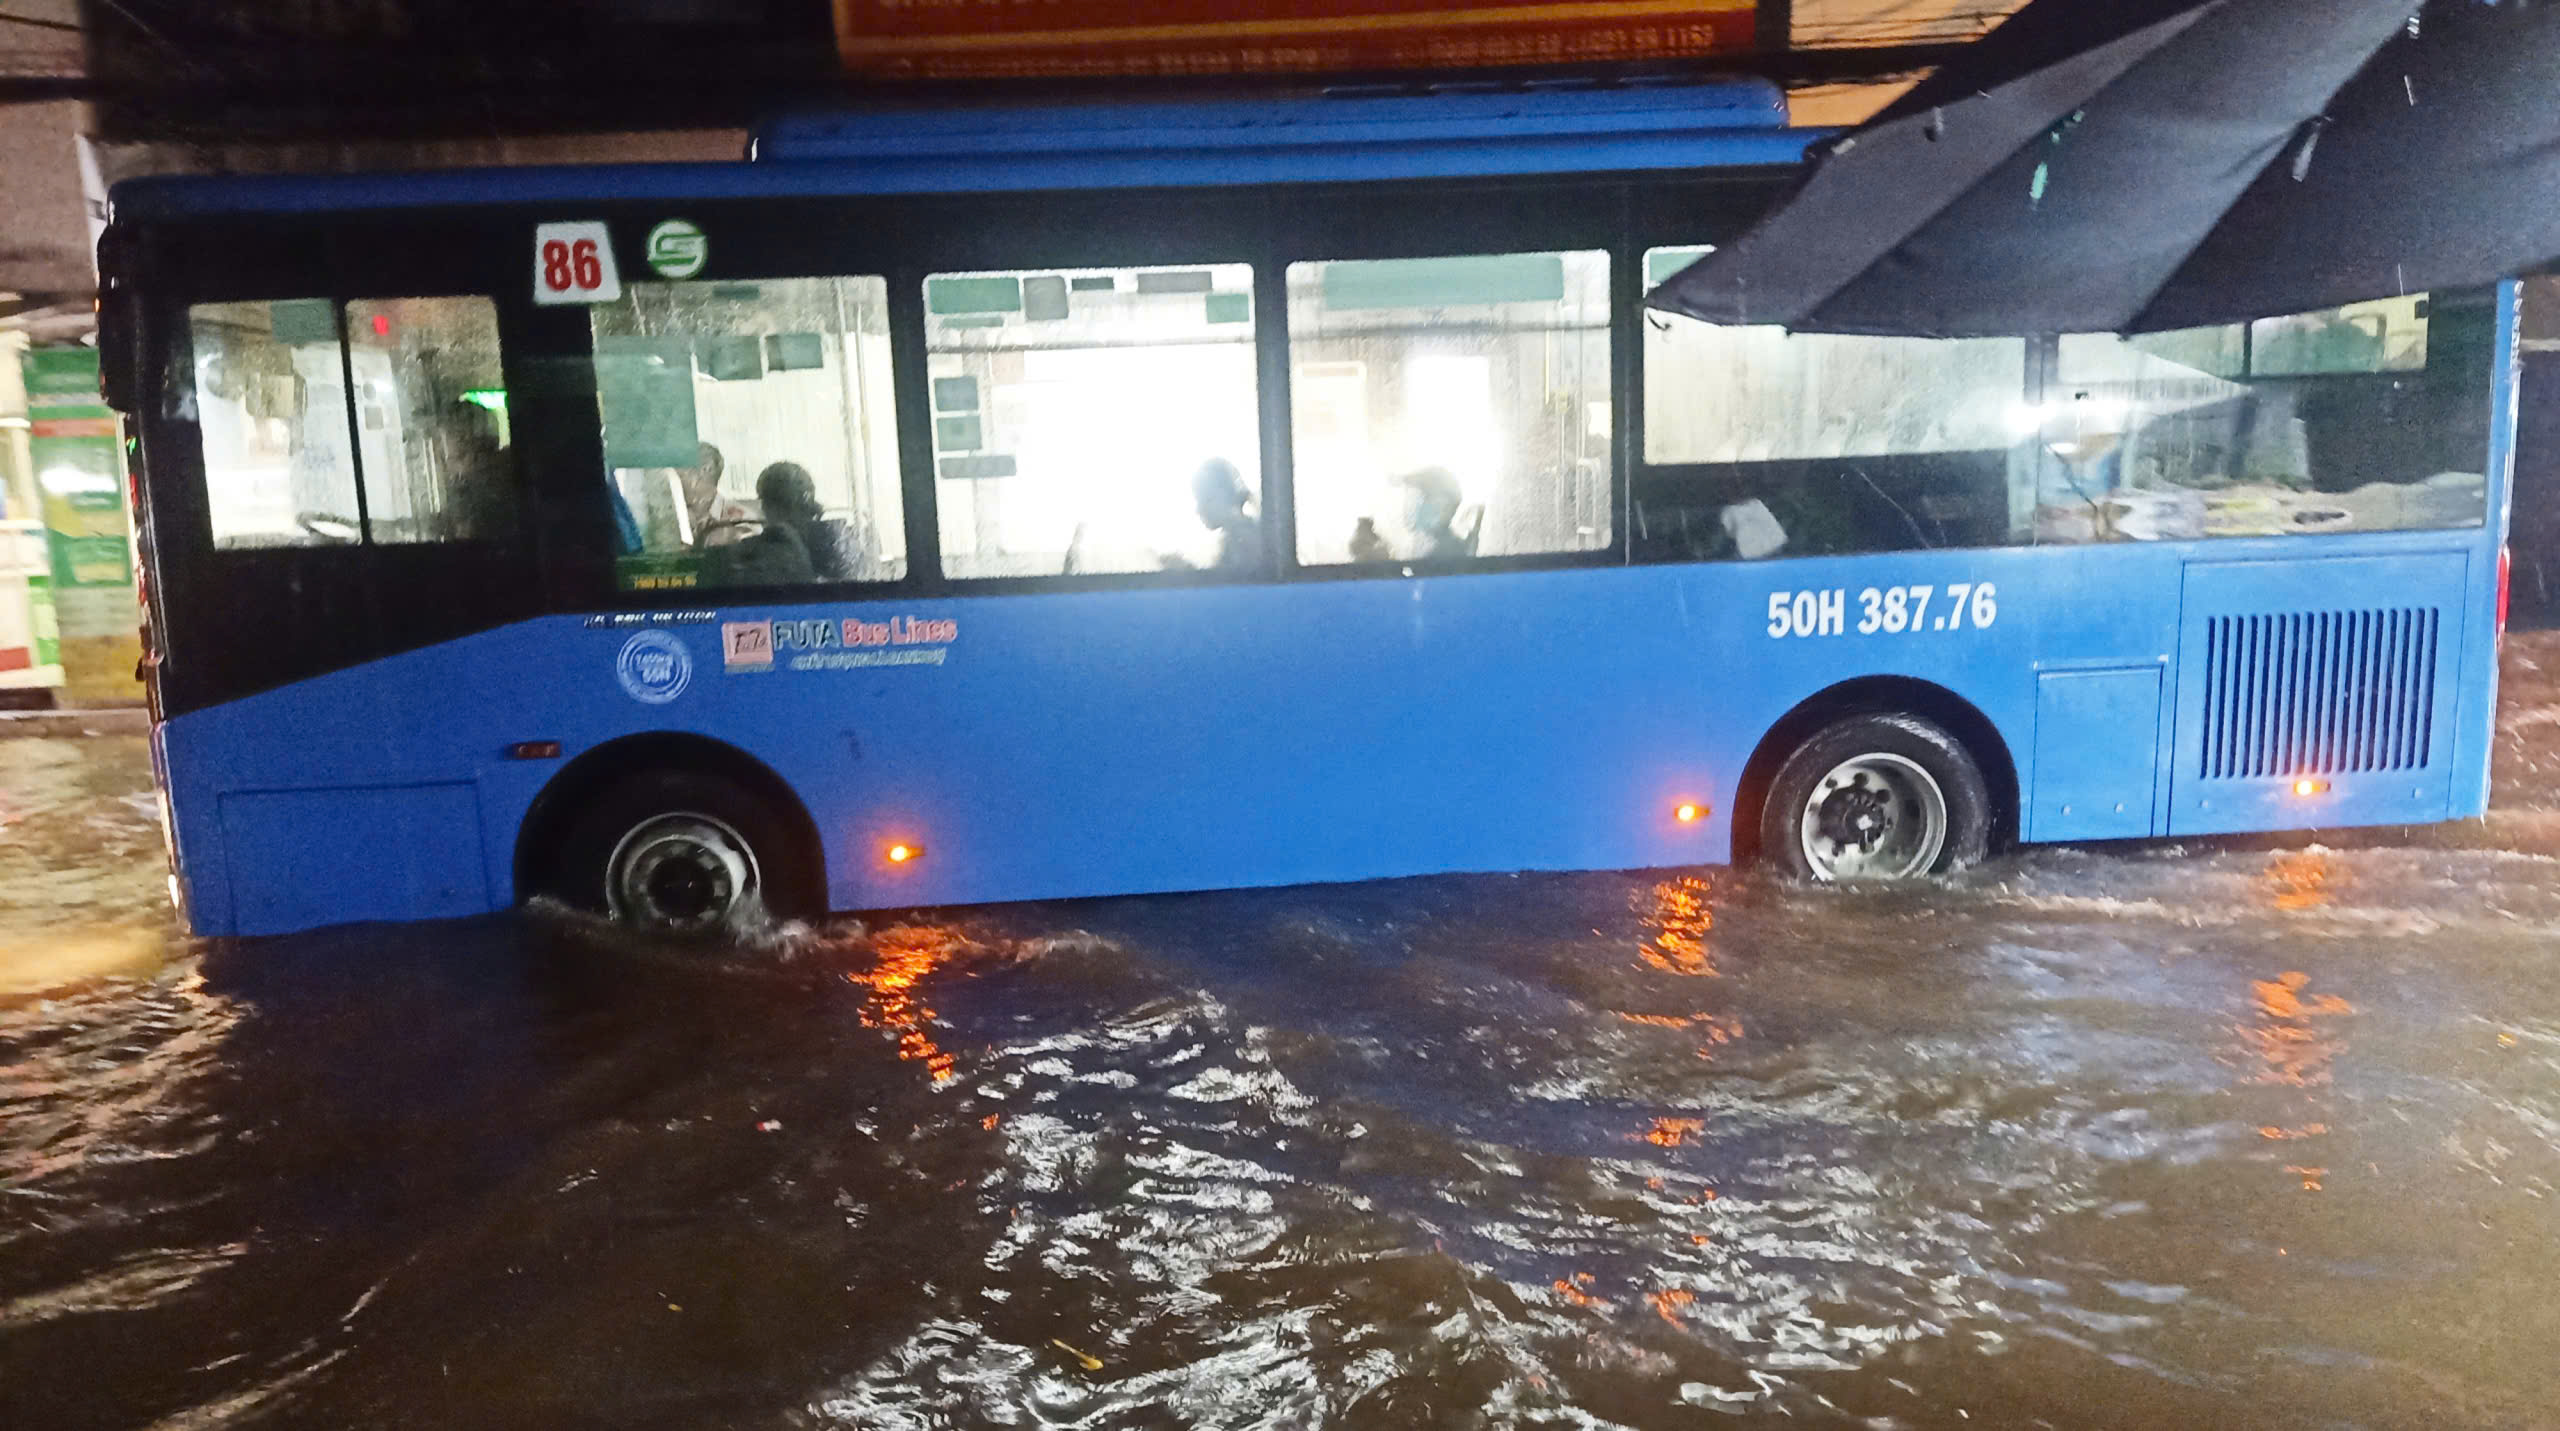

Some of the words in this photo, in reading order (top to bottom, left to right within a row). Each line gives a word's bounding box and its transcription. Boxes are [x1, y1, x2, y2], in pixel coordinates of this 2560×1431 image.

[542, 238, 602, 291] 86
[773, 619, 841, 650] FUTA
[842, 618, 890, 648] Bus
[890, 616, 957, 646] Lines
[1767, 588, 1845, 639] 50H
[1856, 581, 1998, 635] 387.76
